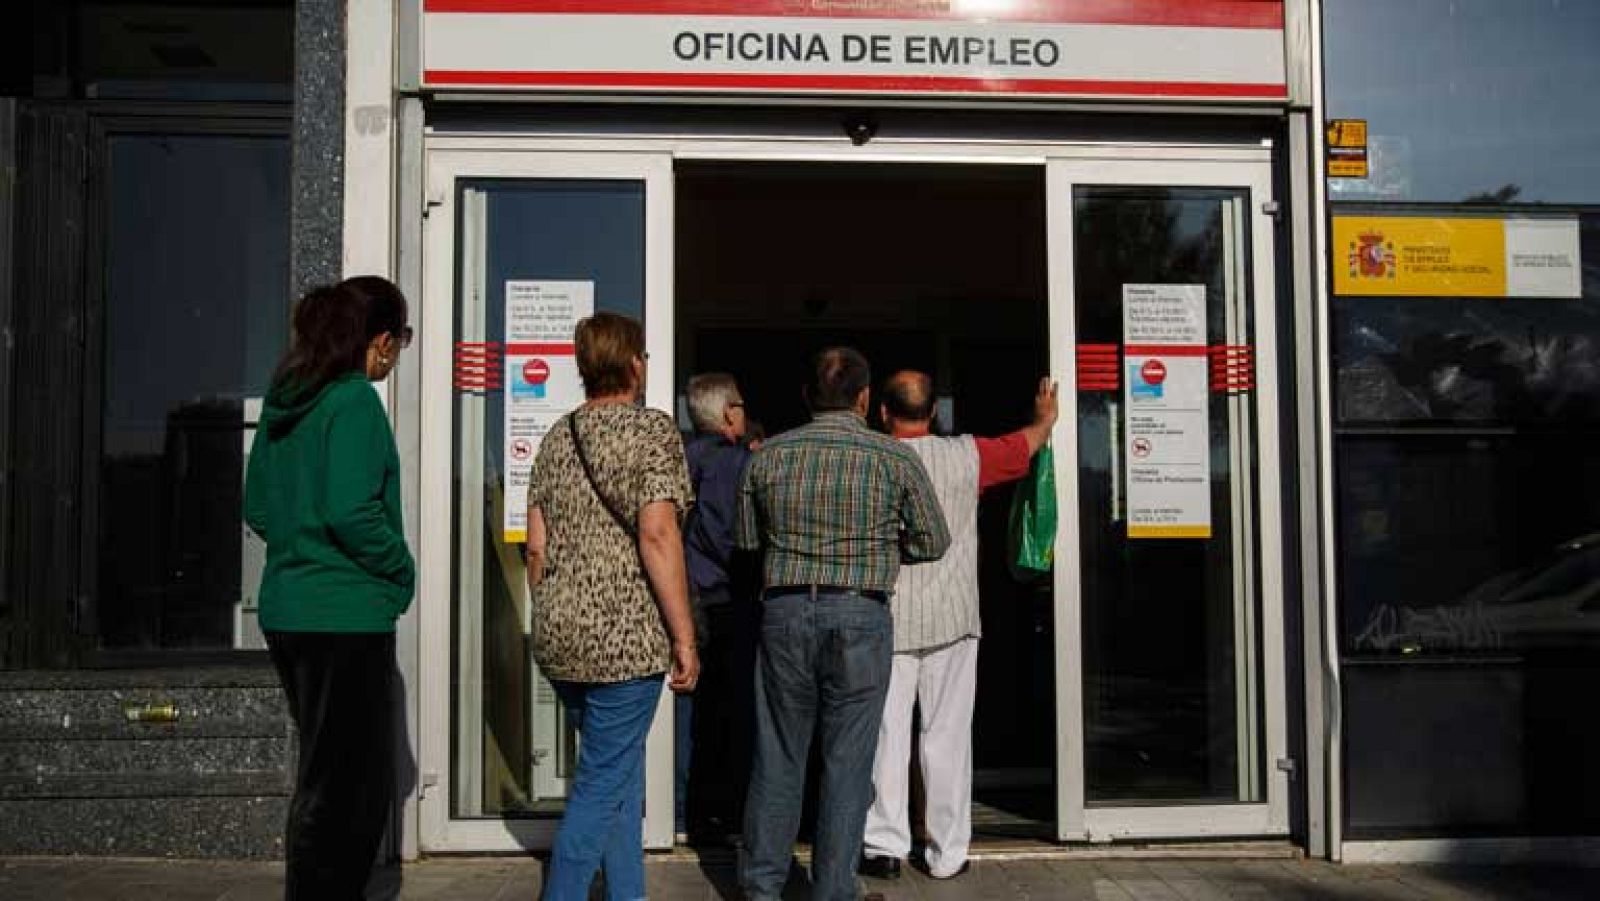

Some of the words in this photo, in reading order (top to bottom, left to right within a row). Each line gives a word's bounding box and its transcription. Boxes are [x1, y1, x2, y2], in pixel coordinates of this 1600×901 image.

[673, 30, 830, 63] OFICINA
[841, 33, 892, 64] DE
[904, 35, 1060, 67] EMPLEO
